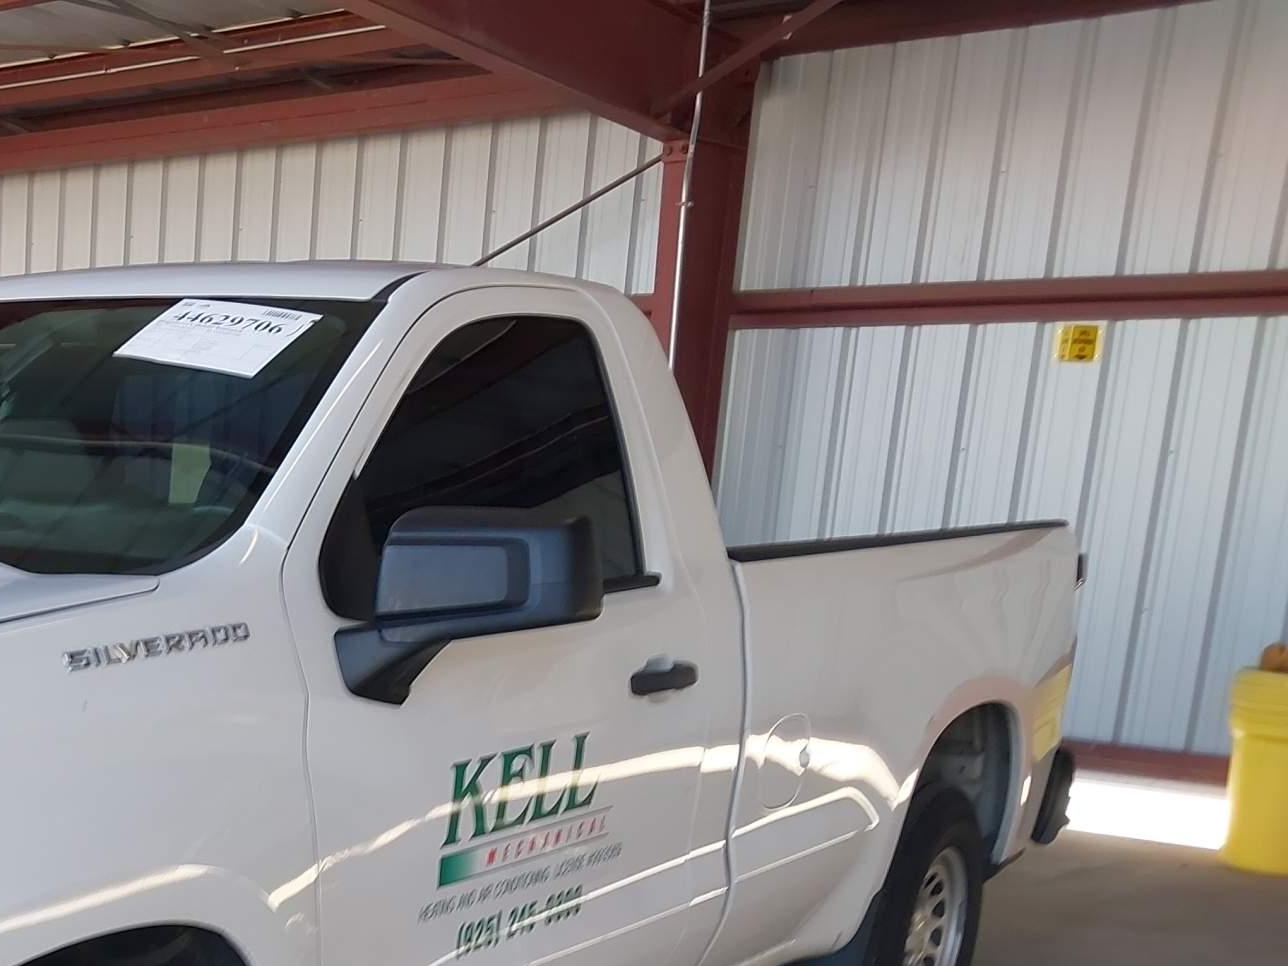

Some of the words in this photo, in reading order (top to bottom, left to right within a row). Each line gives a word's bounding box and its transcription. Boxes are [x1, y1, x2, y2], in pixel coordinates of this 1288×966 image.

[174, 311, 288, 335] 44629706
[62, 622, 251, 673] SILVERADO
[440, 731, 600, 850] KELL
[486, 815, 607, 867] MECHANICAL
